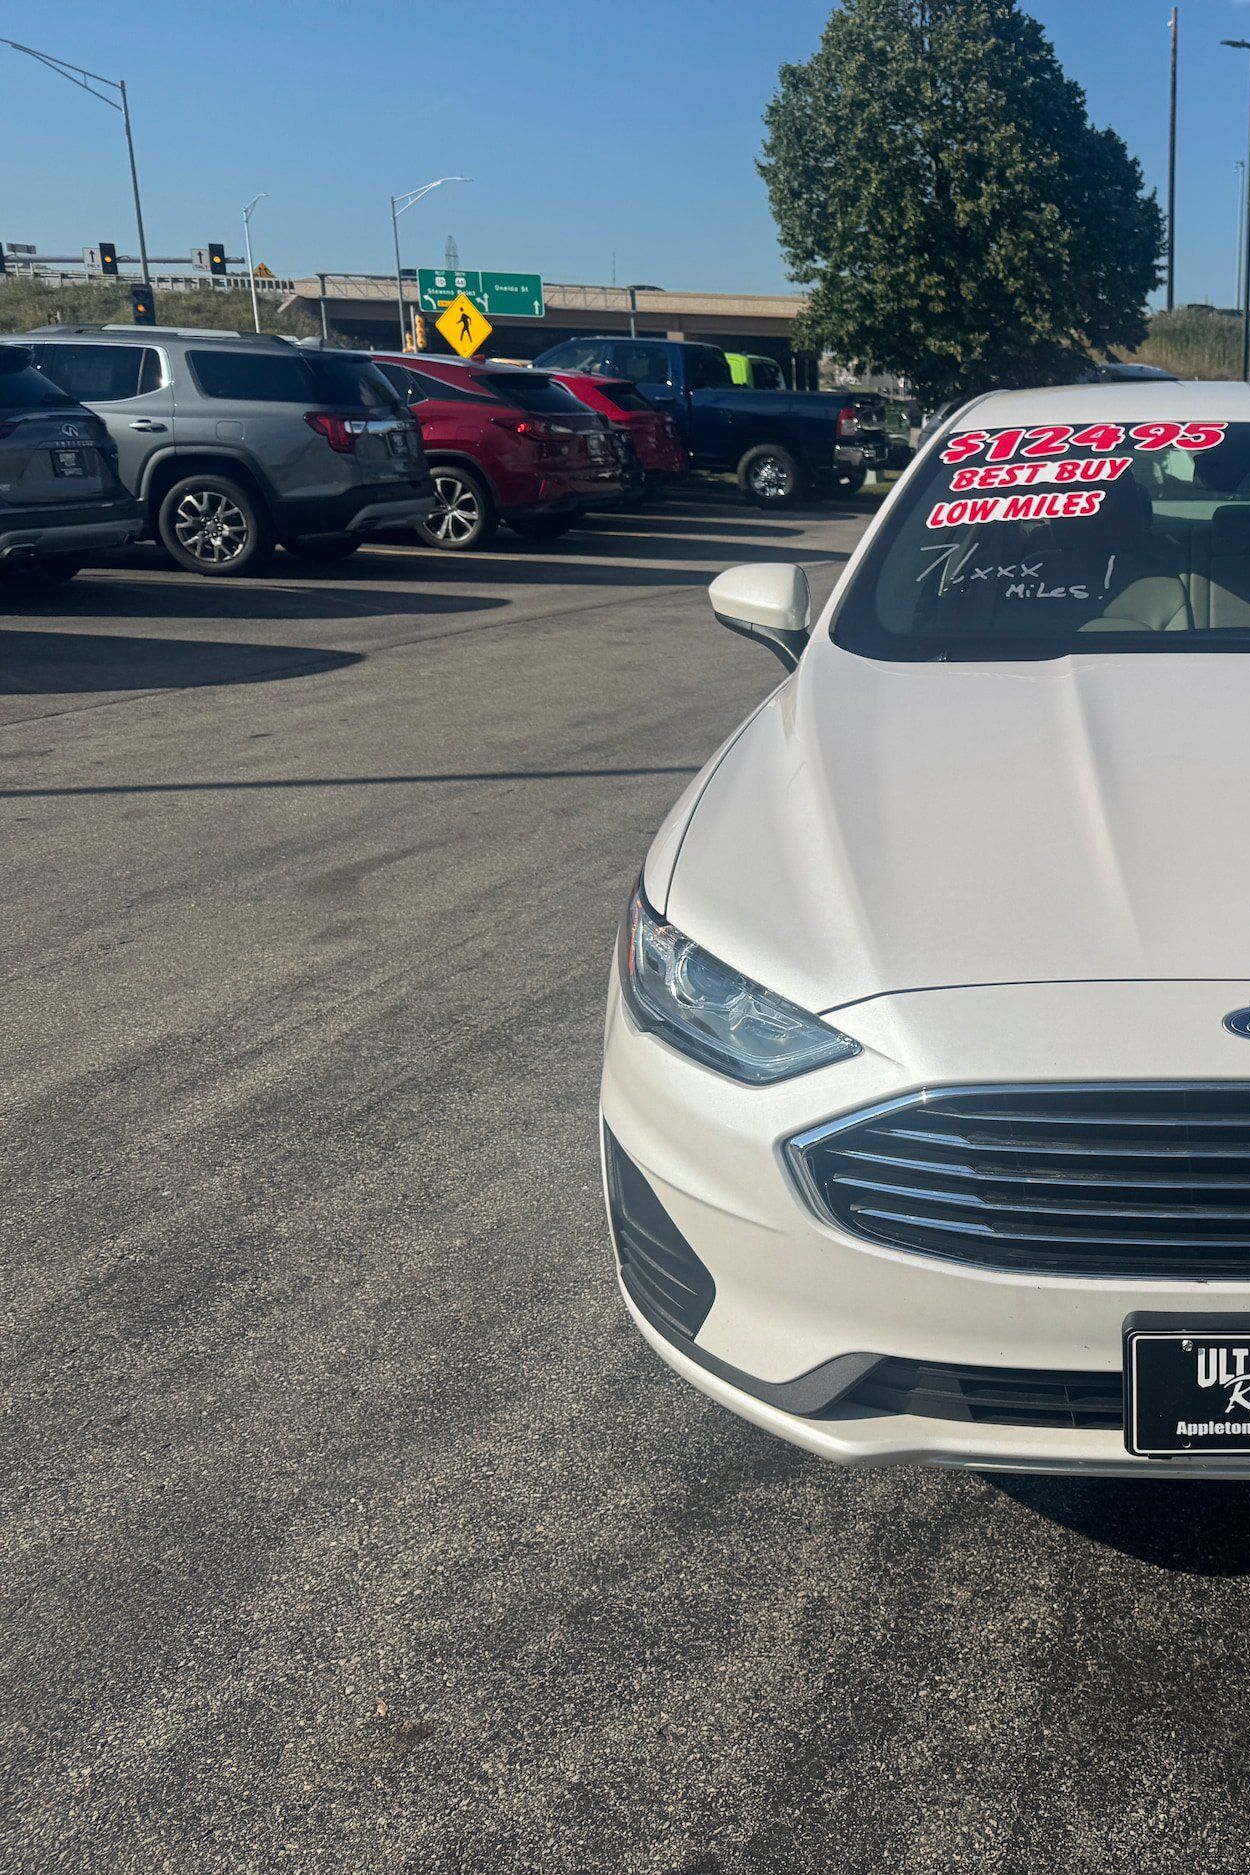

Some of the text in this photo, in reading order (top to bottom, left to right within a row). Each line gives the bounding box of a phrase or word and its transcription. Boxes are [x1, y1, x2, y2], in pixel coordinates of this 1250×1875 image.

[942, 423, 1227, 463] $12495
[952, 459, 1131, 490] BEST BUY
[929, 492, 1103, 527] LOW MILES
